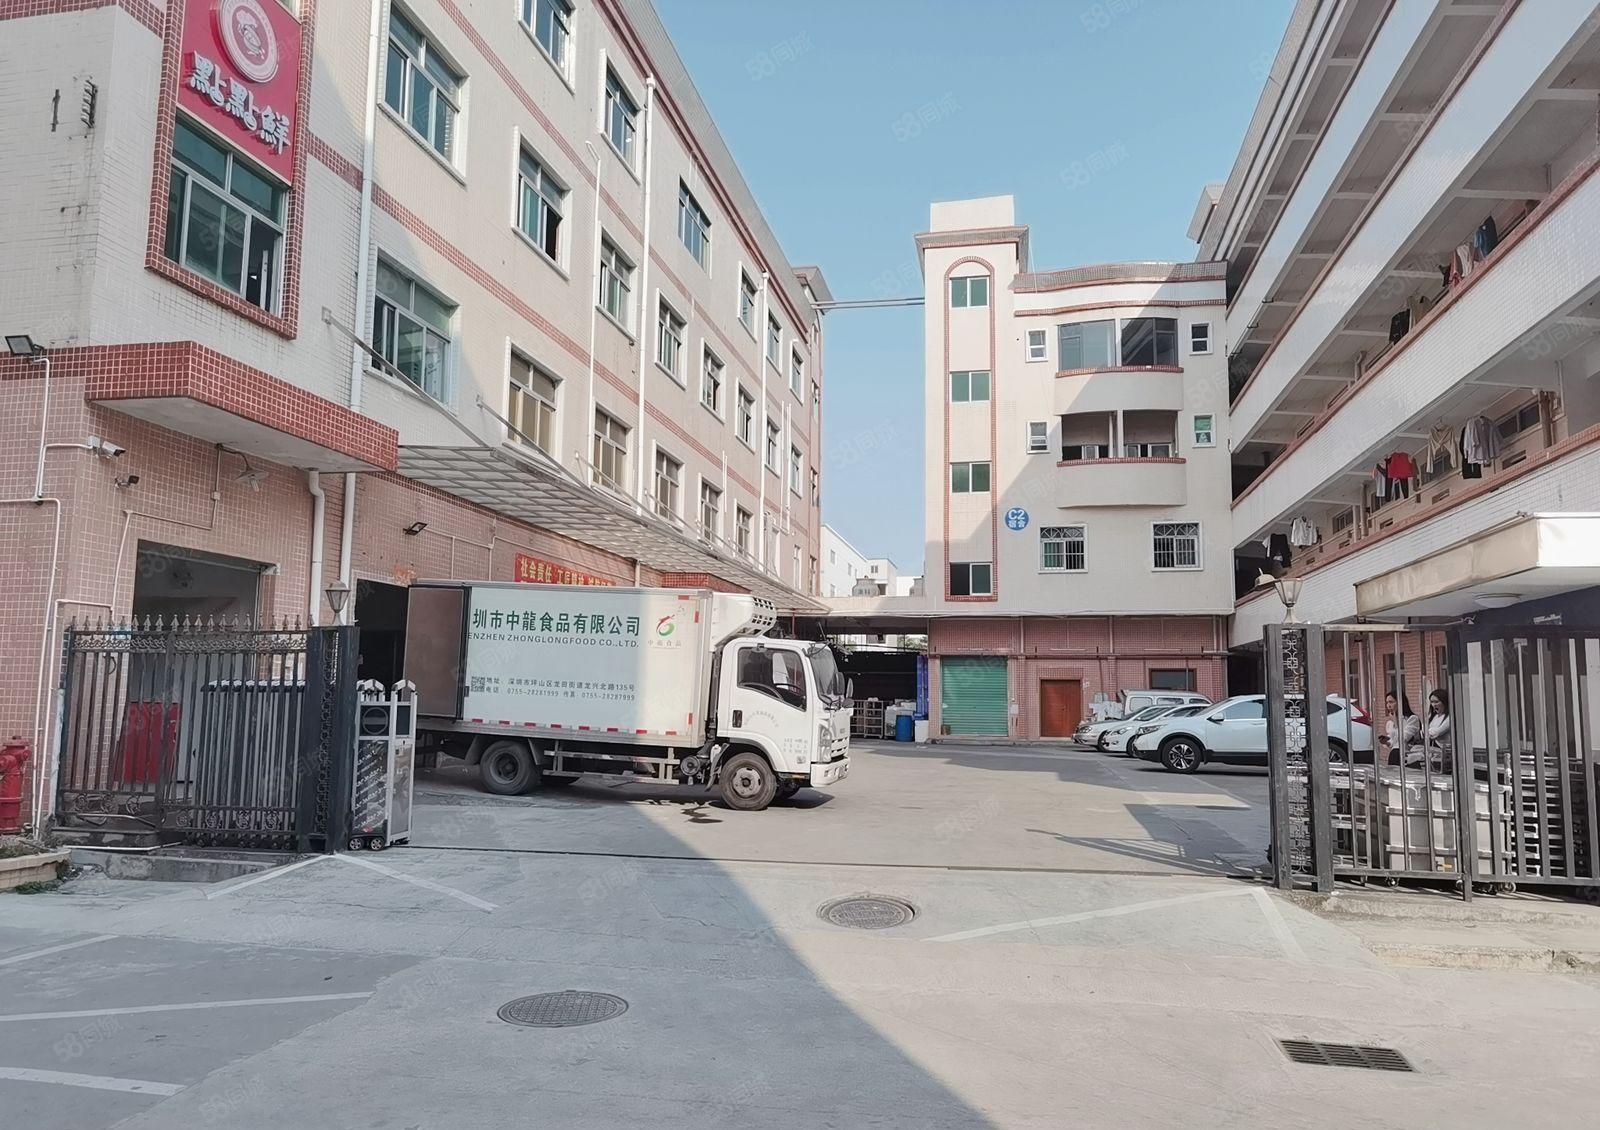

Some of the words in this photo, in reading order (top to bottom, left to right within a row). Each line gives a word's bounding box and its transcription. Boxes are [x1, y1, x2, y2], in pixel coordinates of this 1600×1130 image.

[1008, 509, 1025, 520] C2
[520, 557, 552, 583] 社会责任
